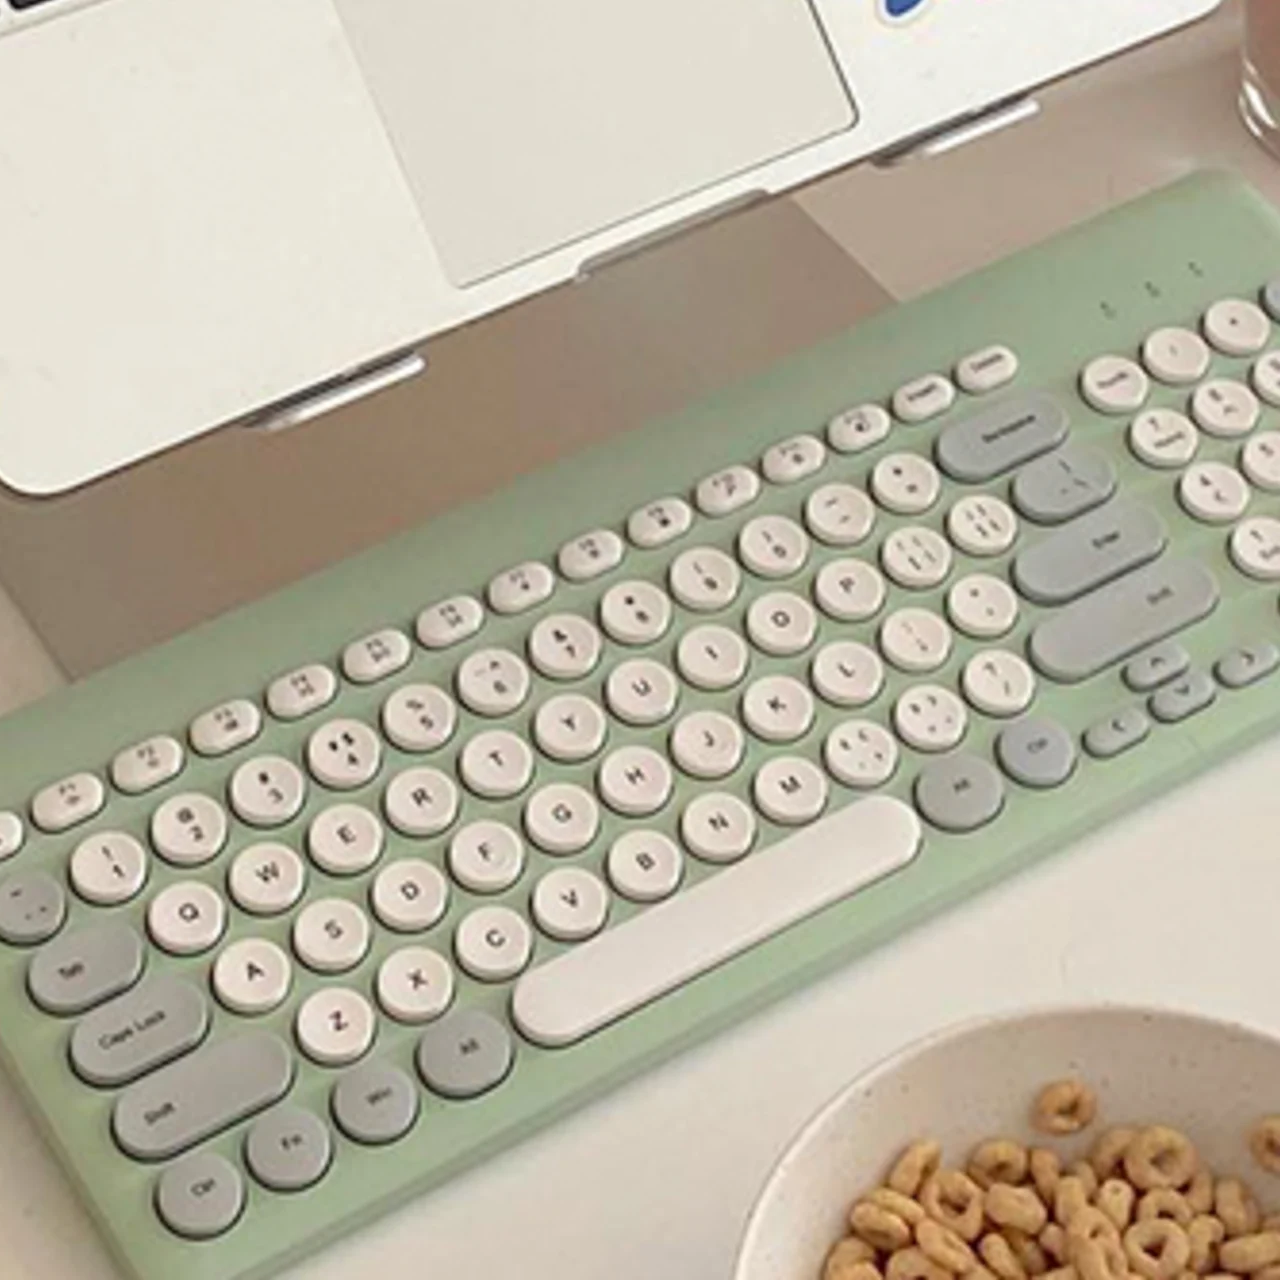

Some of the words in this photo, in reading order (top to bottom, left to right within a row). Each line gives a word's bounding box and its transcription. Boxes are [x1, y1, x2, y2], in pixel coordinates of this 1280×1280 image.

[838, 577, 855, 594] P
[770, 610, 791, 628] O
[837, 663, 855, 679] L
[631, 679, 652, 697] U
[768, 697, 786, 712] K
[562, 716, 576, 731] Y
[704, 731, 715, 748] J
[488, 750, 503, 767] T
[625, 767, 645, 785] H
[779, 775, 802, 794] M
[411, 788, 432, 807] R
[708, 814, 729, 830] N
[336, 825, 356, 845] E
[477, 842, 490, 861] F
[635, 852, 656, 871] B
[255, 861, 280, 883] W
[400, 881, 420, 901] D
[561, 889, 578, 908] V
[178, 902, 200, 923] Q
[324, 919, 344, 940] S
[485, 928, 506, 948] C
[246, 962, 264, 981] A
[409, 970, 427, 990] X
[134, 1009, 166, 1032] Lock
[330, 1010, 349, 1032] Z
